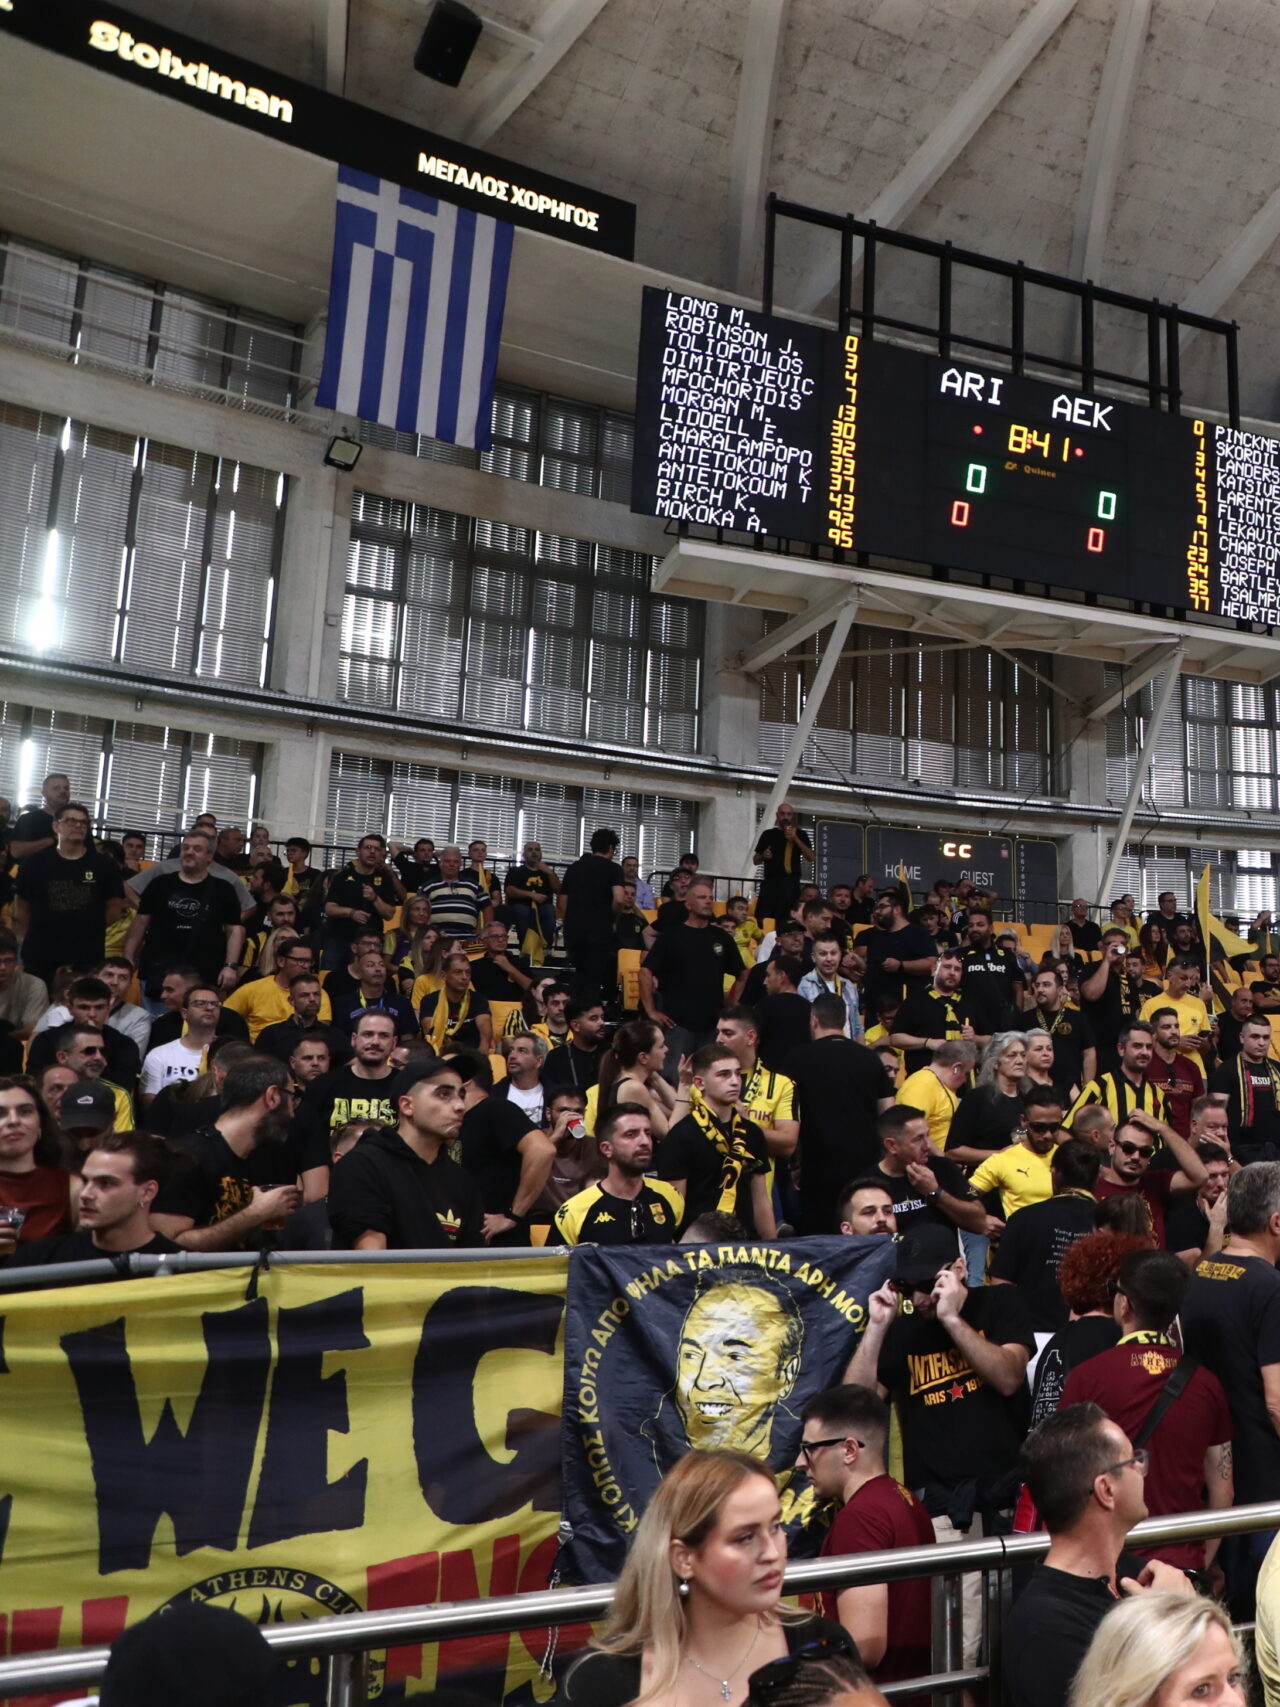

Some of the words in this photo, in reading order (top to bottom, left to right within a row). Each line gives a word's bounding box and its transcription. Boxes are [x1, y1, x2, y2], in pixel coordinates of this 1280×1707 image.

[89, 20, 294, 123] Stoiximan
[418, 152, 510, 202] ΜΕΓΑΛΟΣ
[511, 185, 600, 232] ΧΟΡΗΓΟΣ
[665, 311, 768, 349] ROBINSON
[779, 338, 799, 356] J.
[845, 353, 858, 370] 3
[666, 292, 719, 320] LONG
[730, 308, 751, 327] M.
[845, 335, 859, 353] 0
[663, 348, 815, 396] DIMITRIJEVIC
[845, 387, 857, 404] 7
[666, 329, 804, 375] TOLIOPOULOS
[845, 371, 858, 392] 4
[661, 384, 740, 416] MORGAN
[751, 403, 772, 423] M.
[831, 420, 856, 440] 30
[662, 366, 802, 411] MPOCHORIDIS
[838, 404, 856, 422] 13
[940, 368, 1004, 406] ARI
[1051, 394, 1114, 431] AEK
[660, 403, 750, 437] LIDDELL
[763, 423, 783, 444] E.
[830, 438, 856, 457] 32
[660, 422, 813, 467] CHARALAMPOPO
[830, 456, 855, 476] 33
[1008, 423, 1070, 463] 8:41
[1193, 420, 1204, 436] 0
[1199, 438, 1205, 451] 1
[657, 460, 787, 500] ANTETOKOUM
[800, 486, 812, 503] T
[829, 492, 855, 512] 43
[658, 441, 788, 481] ANTETOKOUM
[799, 468, 812, 486] K
[829, 474, 855, 493] 37
[1195, 451, 1205, 467] 3
[1216, 457, 1280, 485] LANDERS
[1195, 467, 1205, 482] 4
[656, 479, 723, 507] BIRCH
[734, 493, 756, 513] K.
[828, 510, 854, 530] 92
[966, 463, 987, 494] 0
[1097, 491, 1117, 520] 0
[1196, 483, 1206, 498] 5
[1196, 499, 1206, 514] 7
[655, 498, 735, 528] MOKOKA
[746, 514, 768, 534] A.
[828, 528, 854, 548] 95
[951, 500, 970, 526] 0
[1088, 528, 1104, 552] 0
[1193, 530, 1208, 546] 17
[1197, 515, 1207, 530] 9
[1187, 545, 1208, 563] 23
[1219, 553, 1276, 577] JOSEPH
[1187, 562, 1208, 578] 24
[1189, 578, 1209, 596] 35
[1190, 594, 1210, 612] 77
[885, 864, 921, 881] HOME
[960, 870, 994, 886] GUEST
[330, 1097, 396, 1127] ARIS
[625, 1260, 685, 1301] ΨΗΛΑ
[683, 1250, 713, 1271] ΤΑ
[717, 1246, 792, 1271] ΠΑΝΤΑ
[794, 1262, 834, 1299] ΑΡΗ
[591, 1297, 630, 1347] ΑΠΟ
[578, 1347, 602, 1424] ΚΟΙΤΩ
[584, 1430, 622, 1504] ΟΠΩΣ
[190, 1568, 308, 1603] ATHENS
[315, 1583, 365, 1613] CLU
